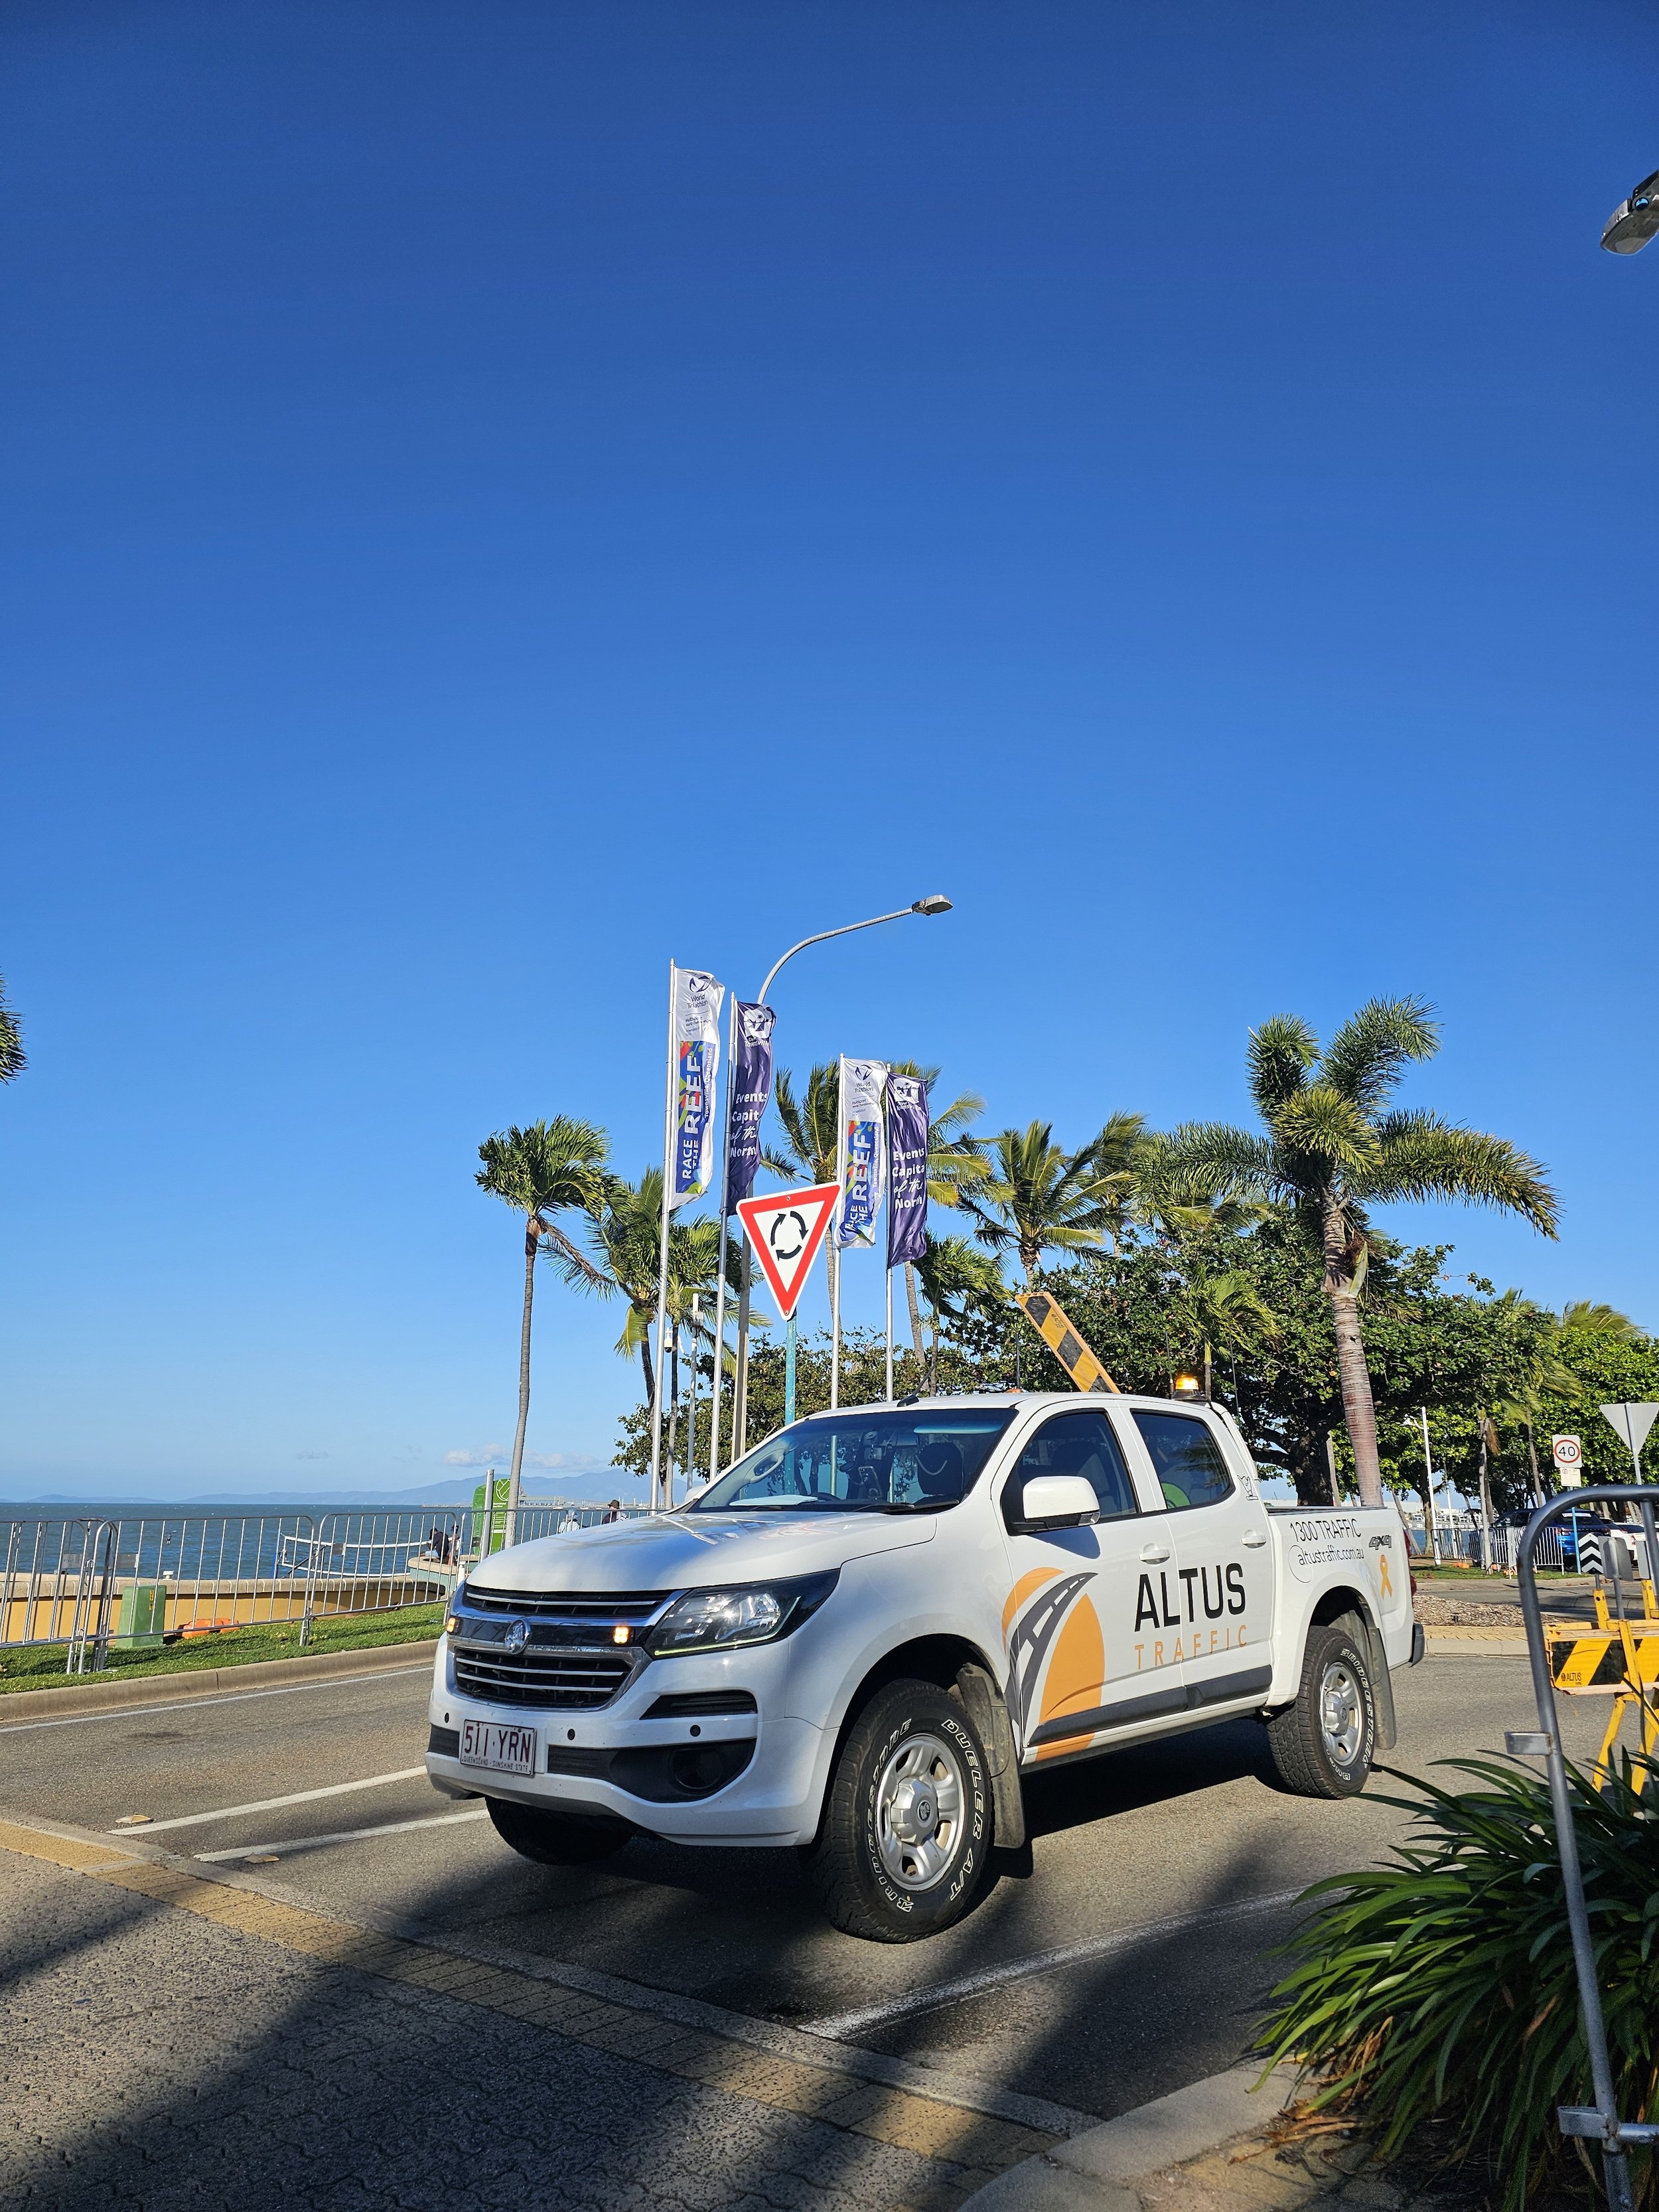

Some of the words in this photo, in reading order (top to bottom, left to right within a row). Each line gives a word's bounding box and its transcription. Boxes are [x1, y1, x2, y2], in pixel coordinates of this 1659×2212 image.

[687, 1000, 708, 1009] Triathlon
[691, 994, 706, 1002] World
[684, 1055, 702, 1134] REEF
[732, 1109, 759, 1124] Capit
[731, 1126, 743, 1146] of
[682, 1139, 693, 1179] RACE
[893, 1147, 924, 1161] Events
[852, 1132, 871, 1202] REEF
[892, 1163, 925, 1179] Capita
[893, 1179, 908, 1199] of
[1558, 1446, 1575, 1457] 40
[1289, 1520, 1318, 1542] 1300
[1315, 1518, 1362, 1540] TRAFFIC
[1297, 1544, 1364, 1566] altustraffic.com.au
[1134, 1562, 1246, 1633] ALTUS
[1134, 1625, 1248, 1670] TRAFFIC
[1566, 1672, 1582, 1682] ALTUS
[498, 1729, 532, 1763] YRN
[492, 1759, 514, 1771] SUNSHINE
[515, 1763, 529, 1773] STATE
[940, 1719, 984, 1841] DUELER
[867, 1718, 914, 1913] BRIDGESTONE
[950, 1848, 974, 1901] A/T
